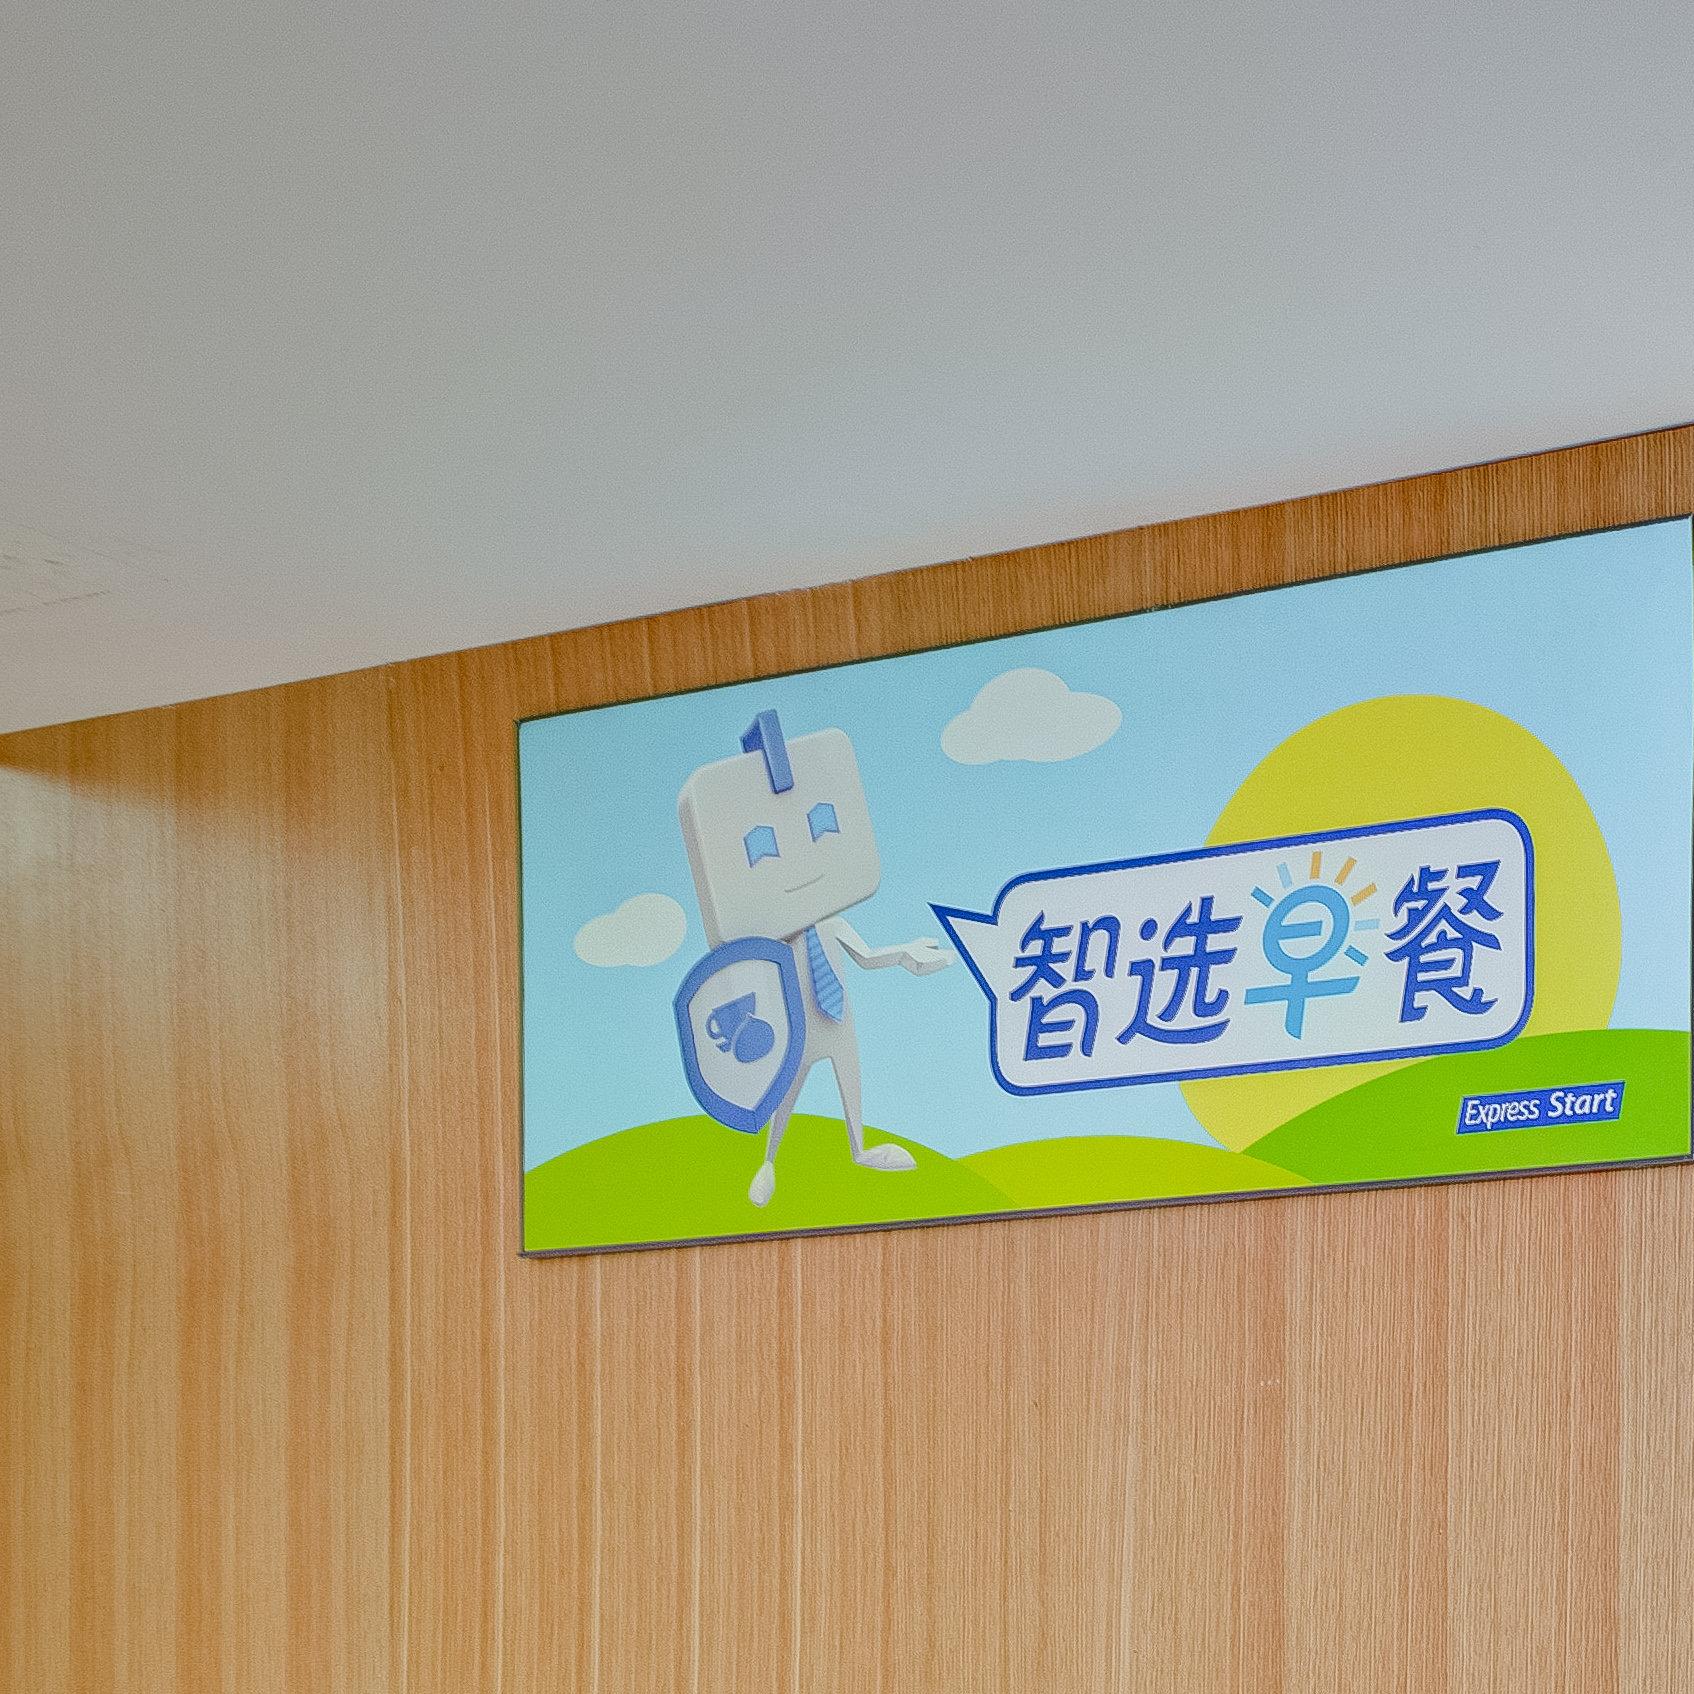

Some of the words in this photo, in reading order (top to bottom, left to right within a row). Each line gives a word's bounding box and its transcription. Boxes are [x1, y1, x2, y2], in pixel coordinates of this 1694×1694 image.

[1010, 856, 1505, 1062] 智选早餐
[1464, 1099, 1541, 1130] Express
[1547, 1088, 1618, 1118] Start
